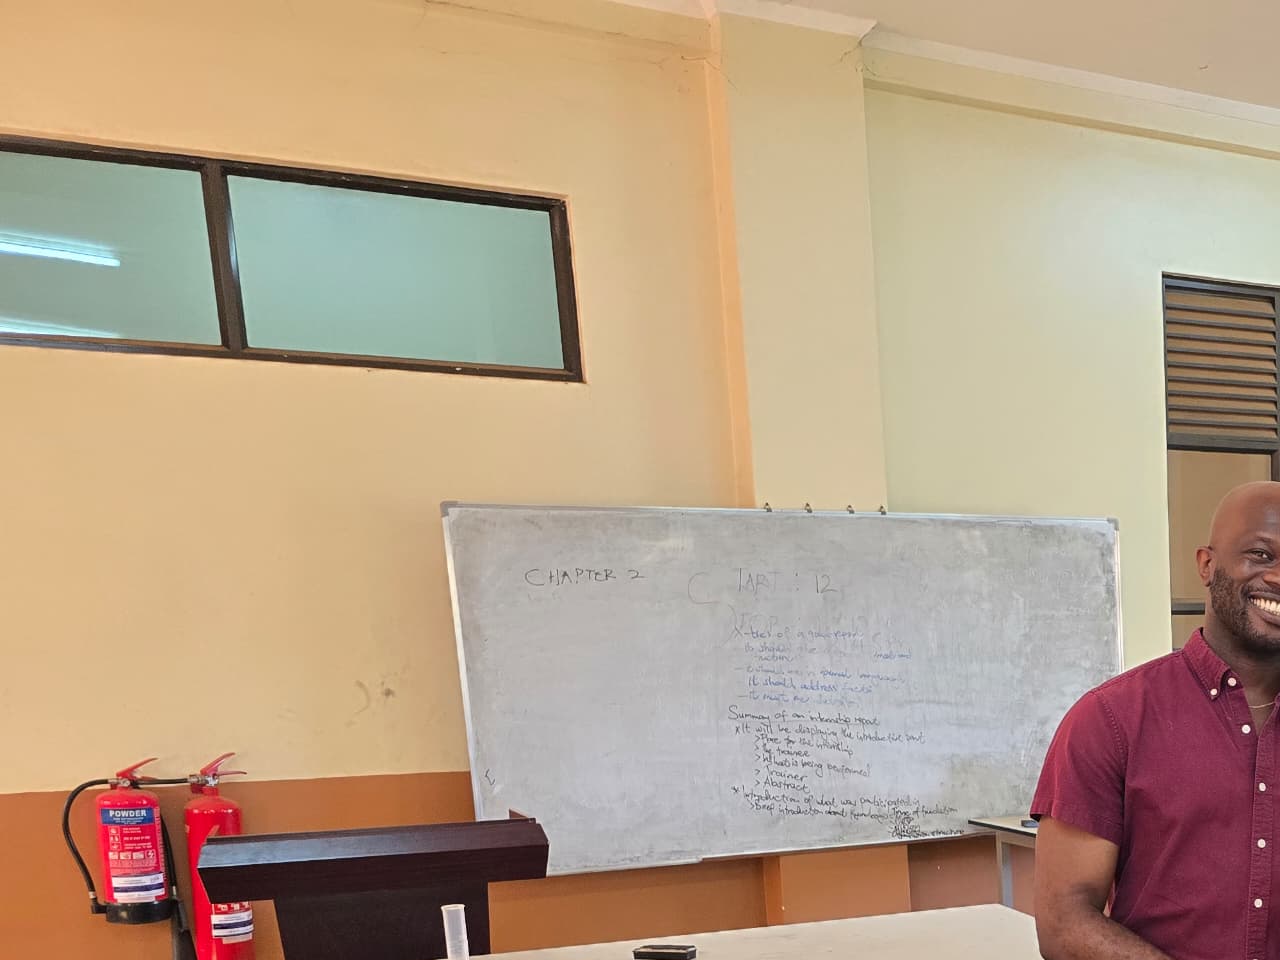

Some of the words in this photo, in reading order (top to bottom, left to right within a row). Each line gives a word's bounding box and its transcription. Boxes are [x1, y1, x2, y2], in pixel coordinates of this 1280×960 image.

[524, 567, 617, 586] CHAPTER
[628, 568, 648, 581] 2
[728, 704, 771, 726] Summary
[774, 710, 787, 723] of
[763, 777, 811, 795] Abstract
[109, 809, 147, 818] POWDER
